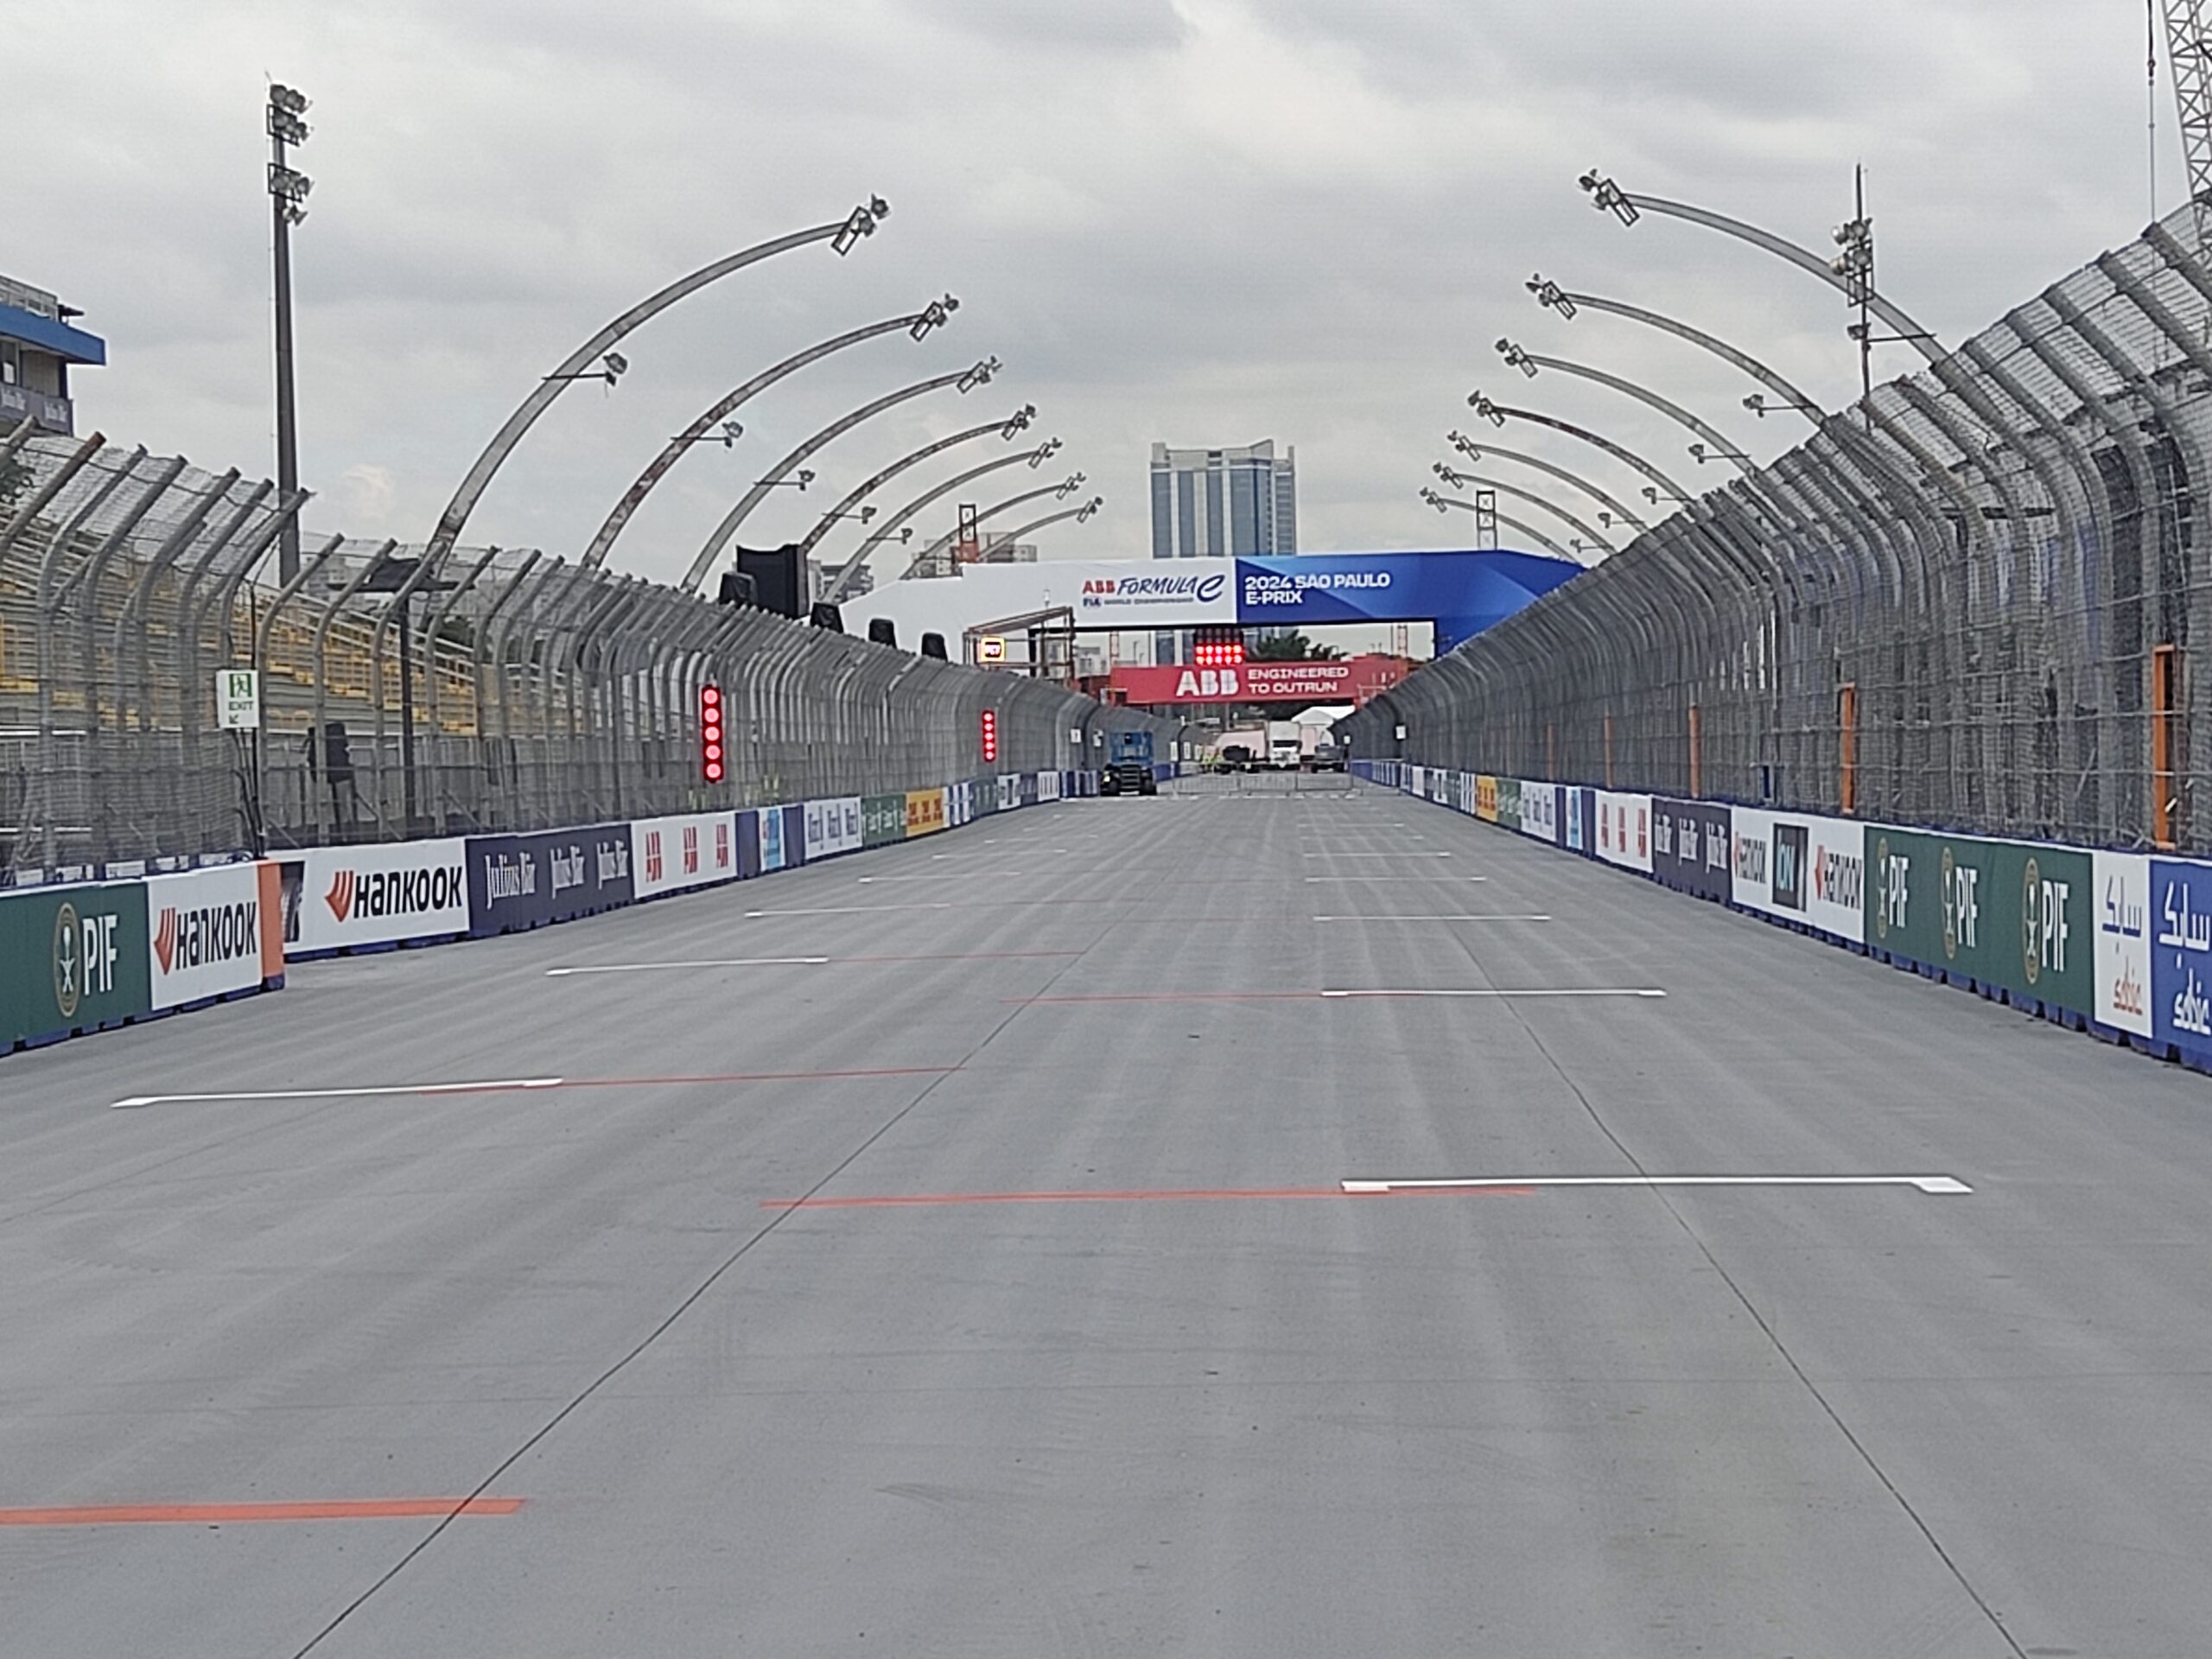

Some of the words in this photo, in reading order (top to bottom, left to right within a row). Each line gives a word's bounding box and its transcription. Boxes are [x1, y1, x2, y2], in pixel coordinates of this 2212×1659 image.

[1083, 580, 1116, 594] ABB
[1116, 576, 1198, 595] FORMULA
[1244, 575, 1293, 590] 2024
[1333, 573, 1391, 588] PAULO
[1245, 590, 1304, 605] E-PRIX
[1175, 669, 1239, 696] ABB
[1247, 666, 1349, 680] ENGINEERED
[1248, 683, 1269, 694] TO
[1272, 681, 1338, 693] OUTRUN
[228, 701, 254, 711] EXIT
[1889, 855, 1910, 929] PIF
[1955, 867, 1978, 948] PIF
[2042, 880, 2069, 972] PIF
[82, 913, 119, 996] PIF
